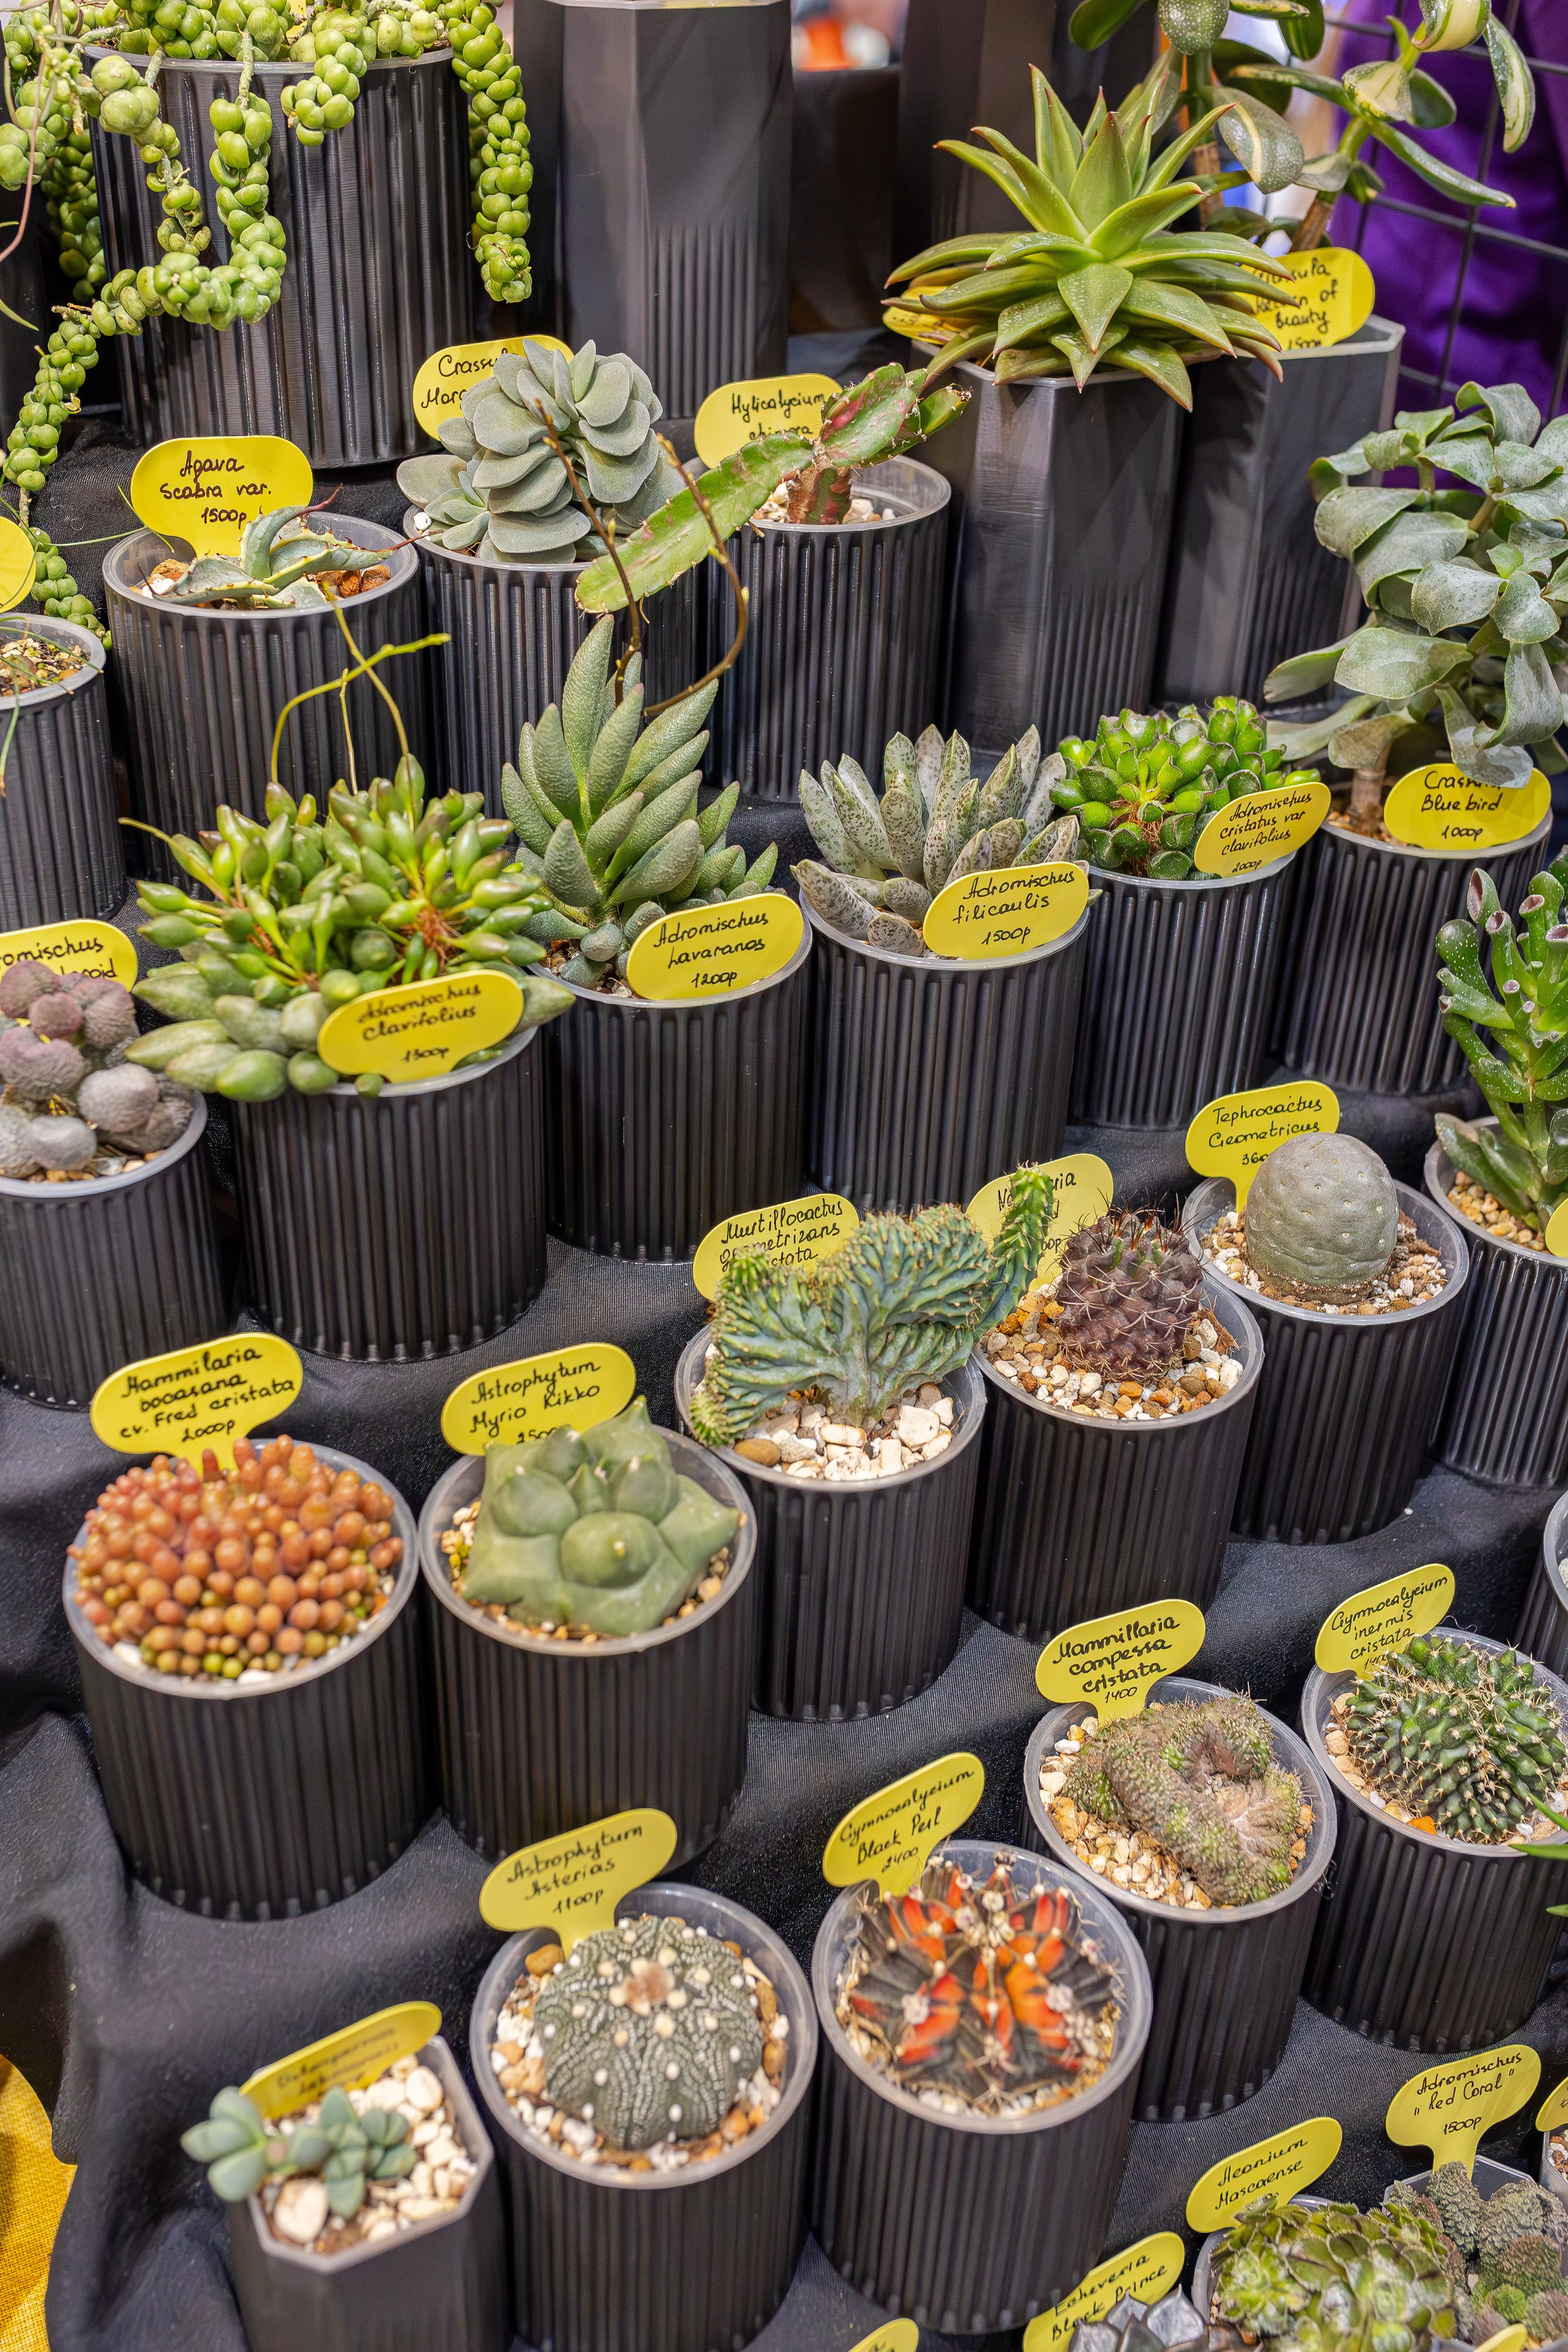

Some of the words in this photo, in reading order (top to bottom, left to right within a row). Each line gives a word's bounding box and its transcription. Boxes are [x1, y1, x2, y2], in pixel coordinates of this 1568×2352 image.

[179, 450, 244, 483] Agava
[160, 483, 222, 500] Scabra
[236, 483, 271, 496] var.
[1284, 810, 1306, 823] var
[962, 870, 1076, 900] Adromischus
[952, 892, 1050, 924] filicaulis
[653, 911, 769, 948] Adromischus
[1213, 1095, 1323, 1127] Tephrocactus
[1208, 1120, 1320, 1148] Geometricus
[472, 1361, 601, 1404] Astrophytum
[154, 1403, 197, 1428] Fred
[469, 1407, 527, 1438] Myrio
[543, 1385, 600, 1409] Kikko
[1331, 1577, 1447, 1634] Gymnocalycium
[1350, 1627, 1415, 1660] cristata
[1082, 1662, 1167, 1694] cristata
[1104, 1687, 1138, 1703] 1400
[507, 1825, 643, 1883] Astrophytum
[858, 1829, 901, 1866] Black
[524, 1858, 616, 1901] Asterias
[1417, 2052, 1523, 2095] Adromischus
[1218, 2138, 1308, 2187] Aeonium
